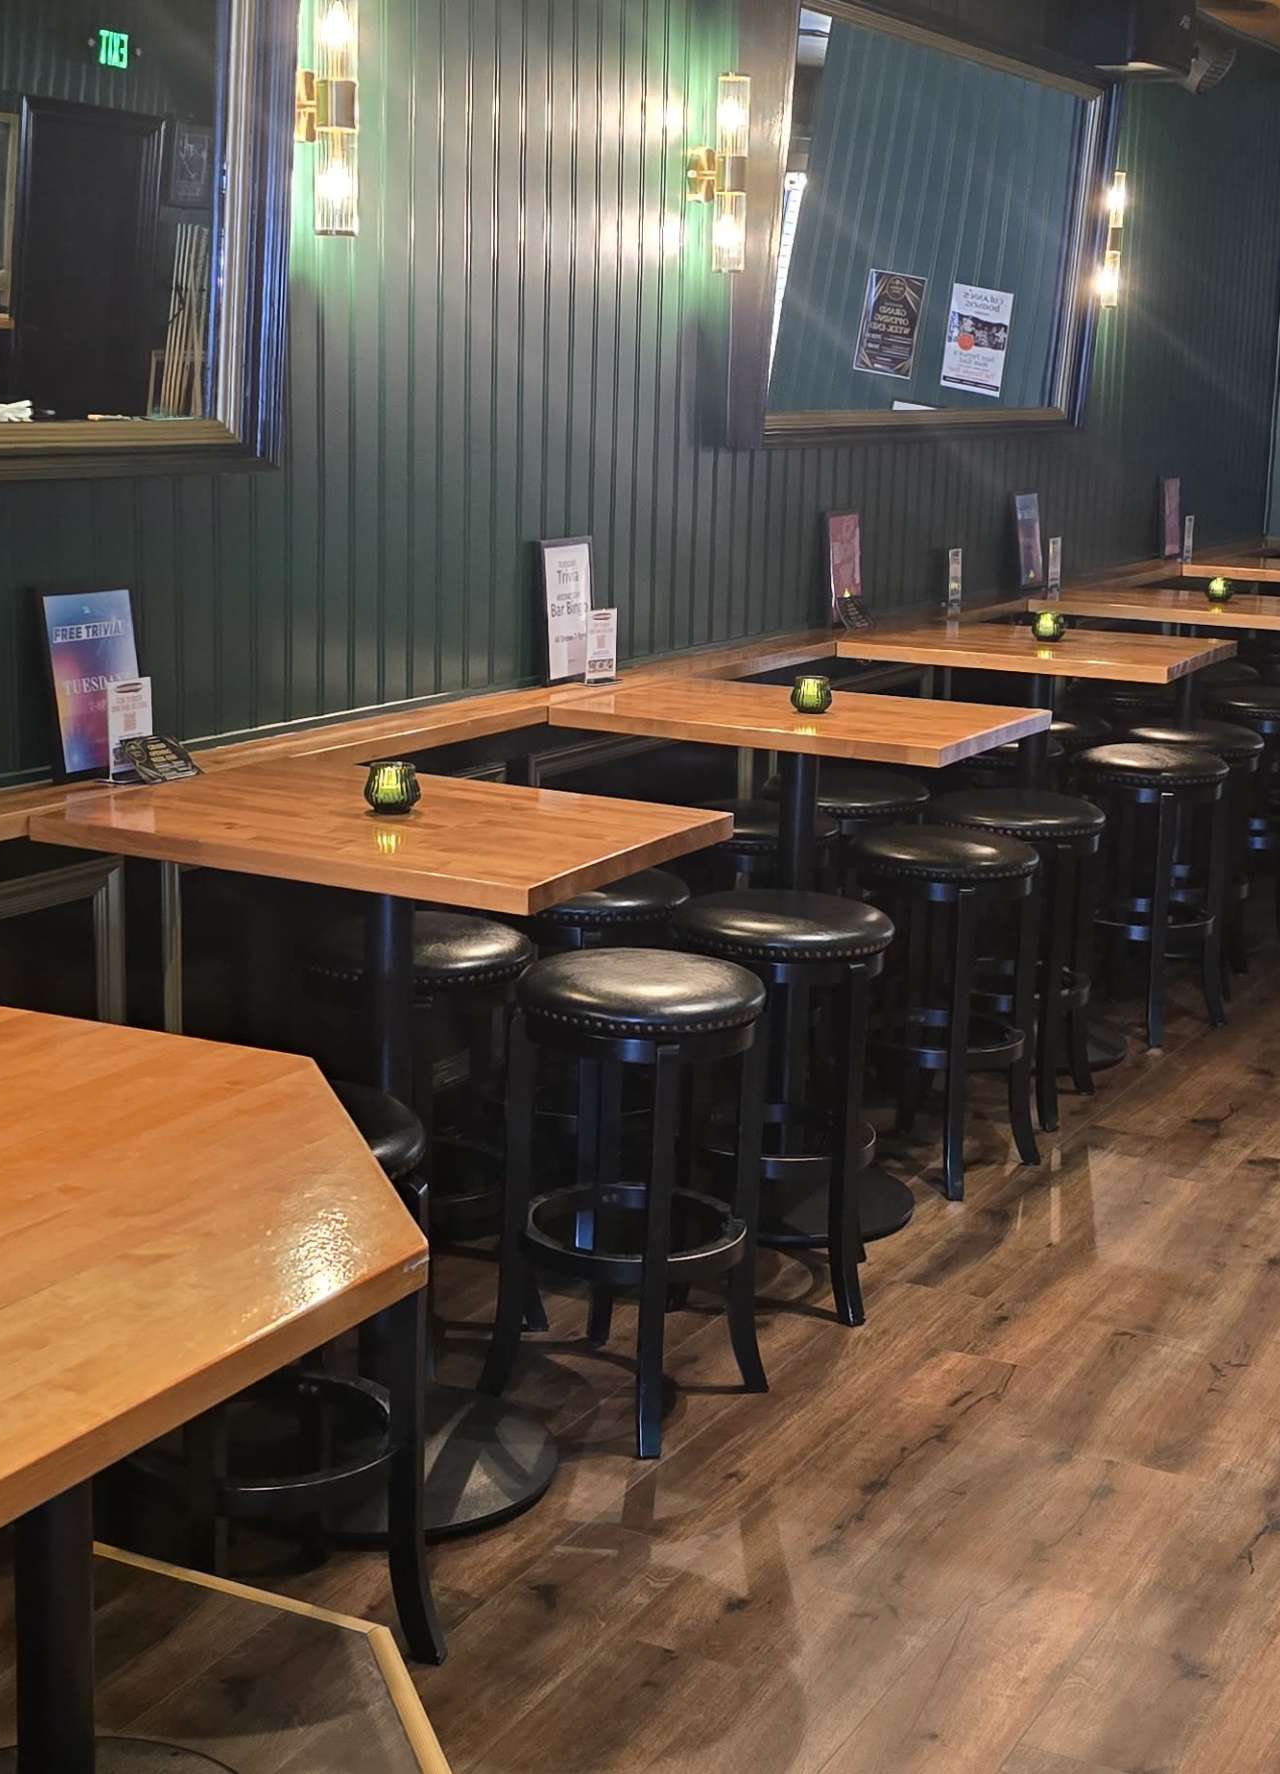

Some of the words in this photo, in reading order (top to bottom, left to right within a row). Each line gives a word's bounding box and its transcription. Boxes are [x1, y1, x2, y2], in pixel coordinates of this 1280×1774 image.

[556, 569, 580, 584] Trivia
[551, 603, 565, 618] Bar
[54, 626, 82, 641] FREE
